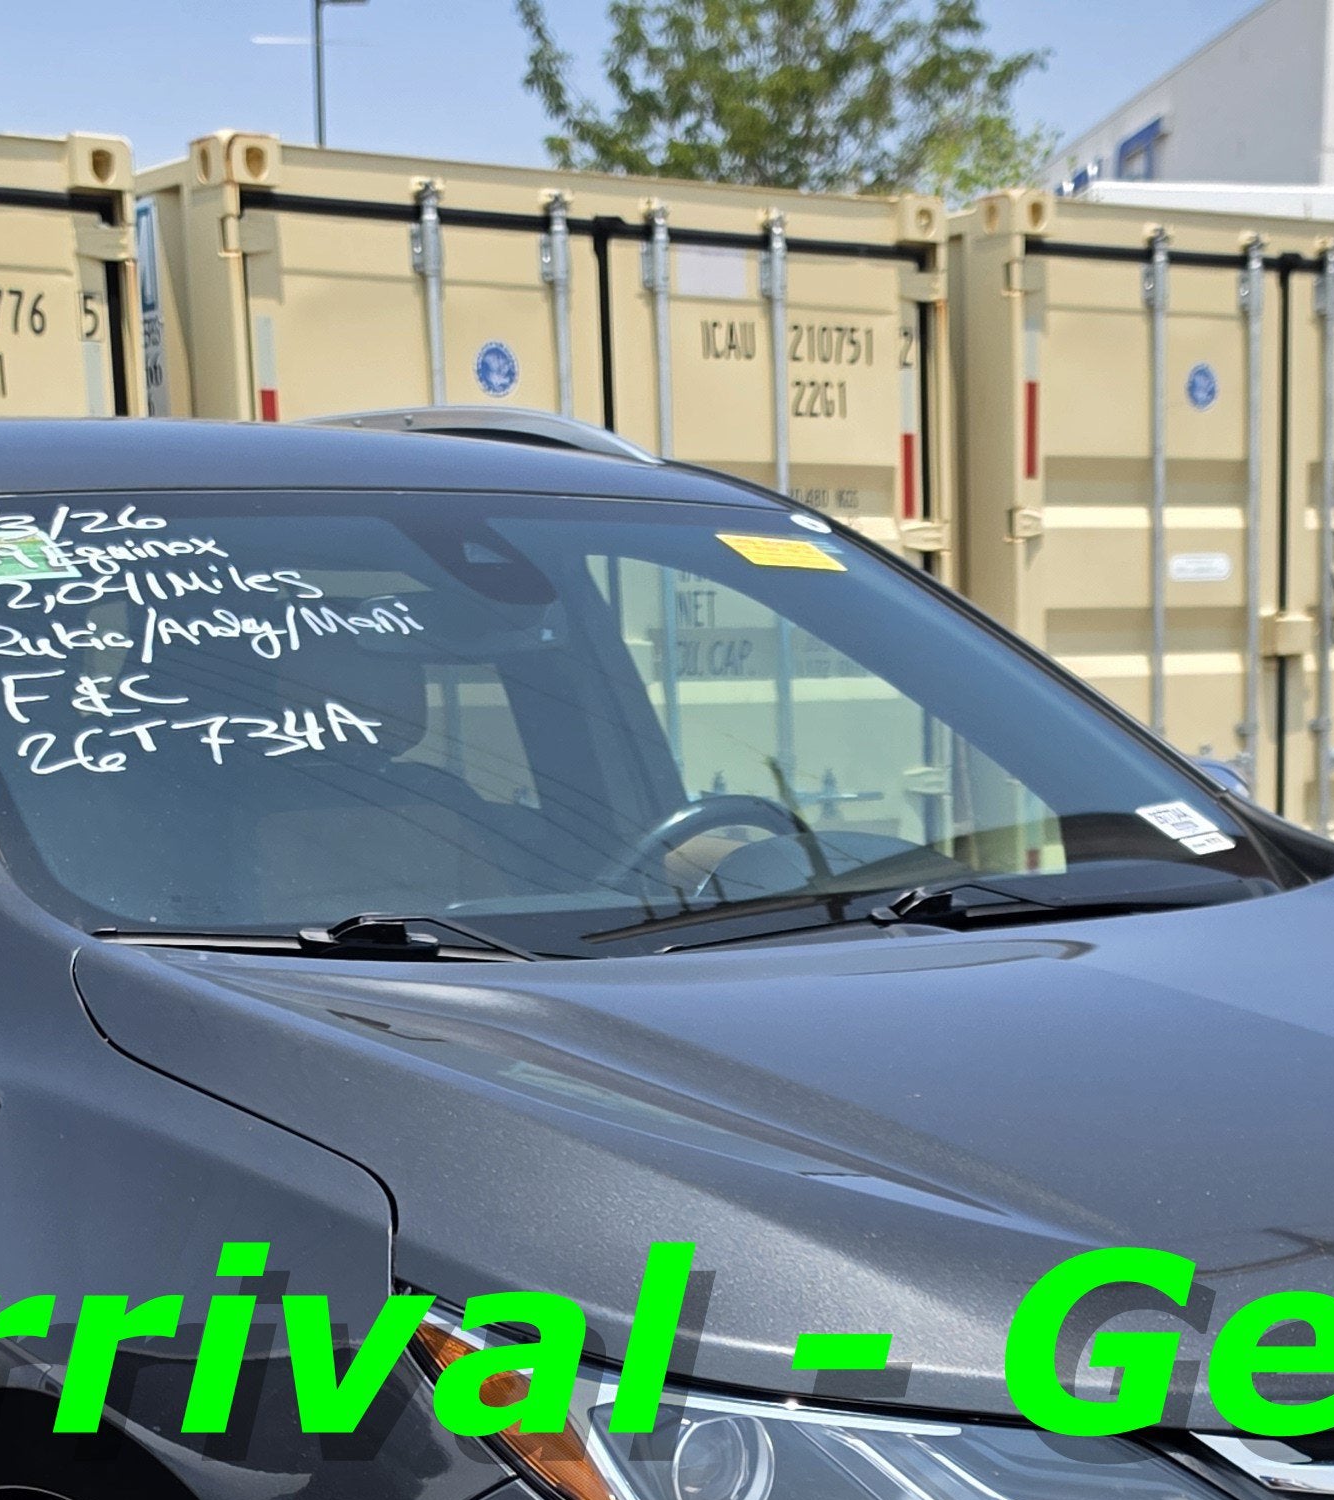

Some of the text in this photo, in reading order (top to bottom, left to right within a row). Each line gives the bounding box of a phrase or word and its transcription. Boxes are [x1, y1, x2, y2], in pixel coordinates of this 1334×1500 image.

[82, 294, 101, 339] 5
[700, 319, 915, 370] ICAU 210751 2
[791, 379, 848, 419] 22G1
[676, 590, 716, 628] NET
